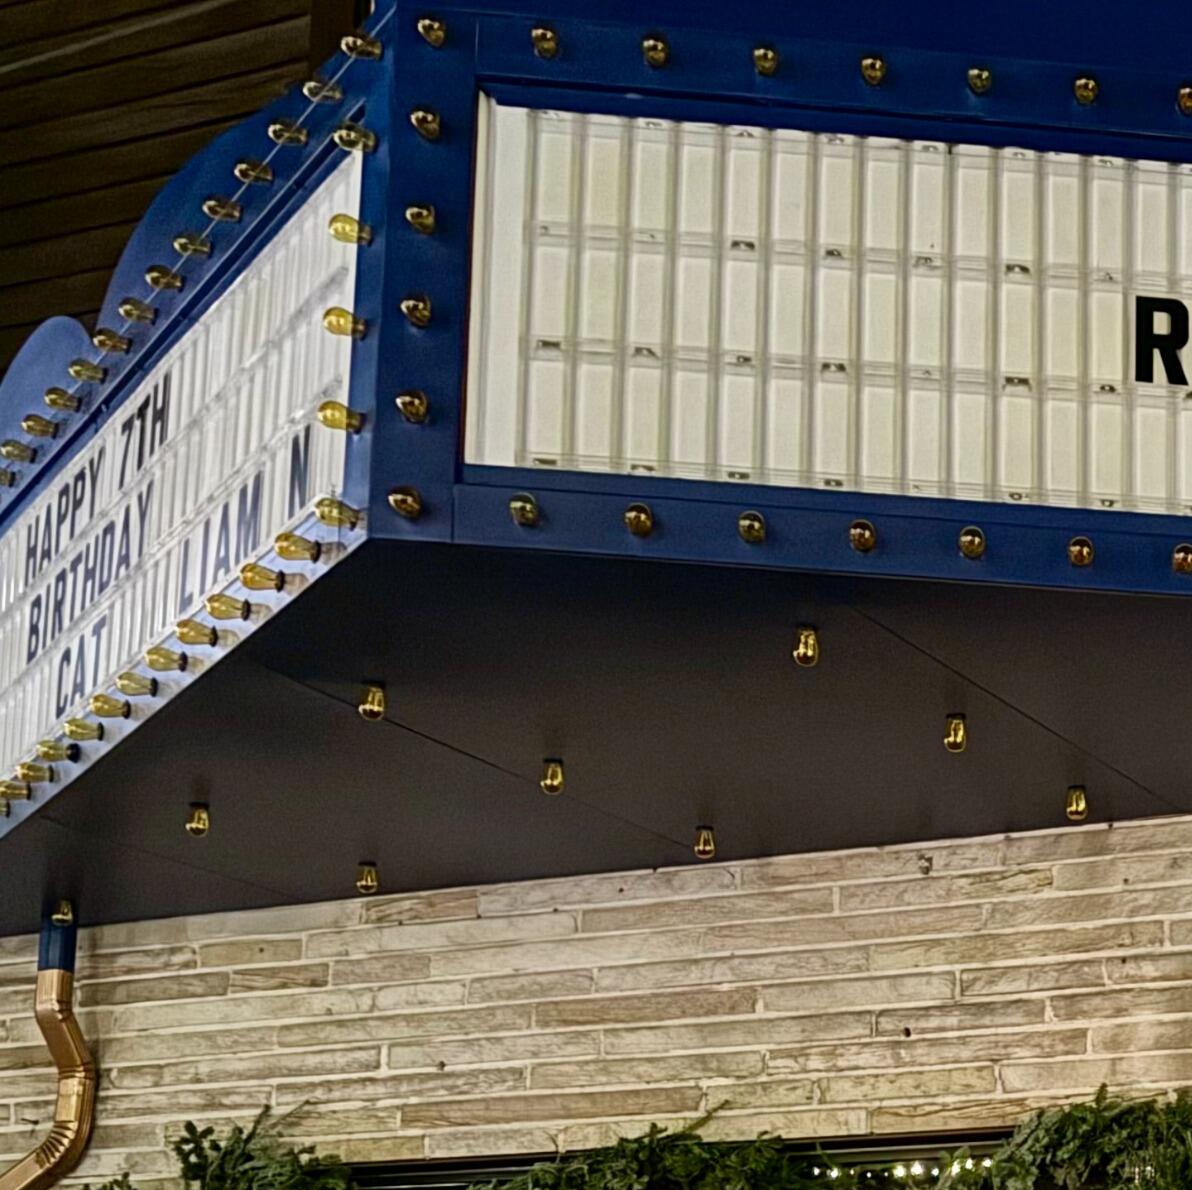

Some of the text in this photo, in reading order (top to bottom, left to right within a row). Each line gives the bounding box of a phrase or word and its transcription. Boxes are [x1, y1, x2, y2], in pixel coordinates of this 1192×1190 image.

[25, 372, 171, 587] HAPPY 7TH
[27, 479, 153, 665] BIRTHDAY
[56, 613, 107, 720] CAT
[288, 424, 311, 521] N
